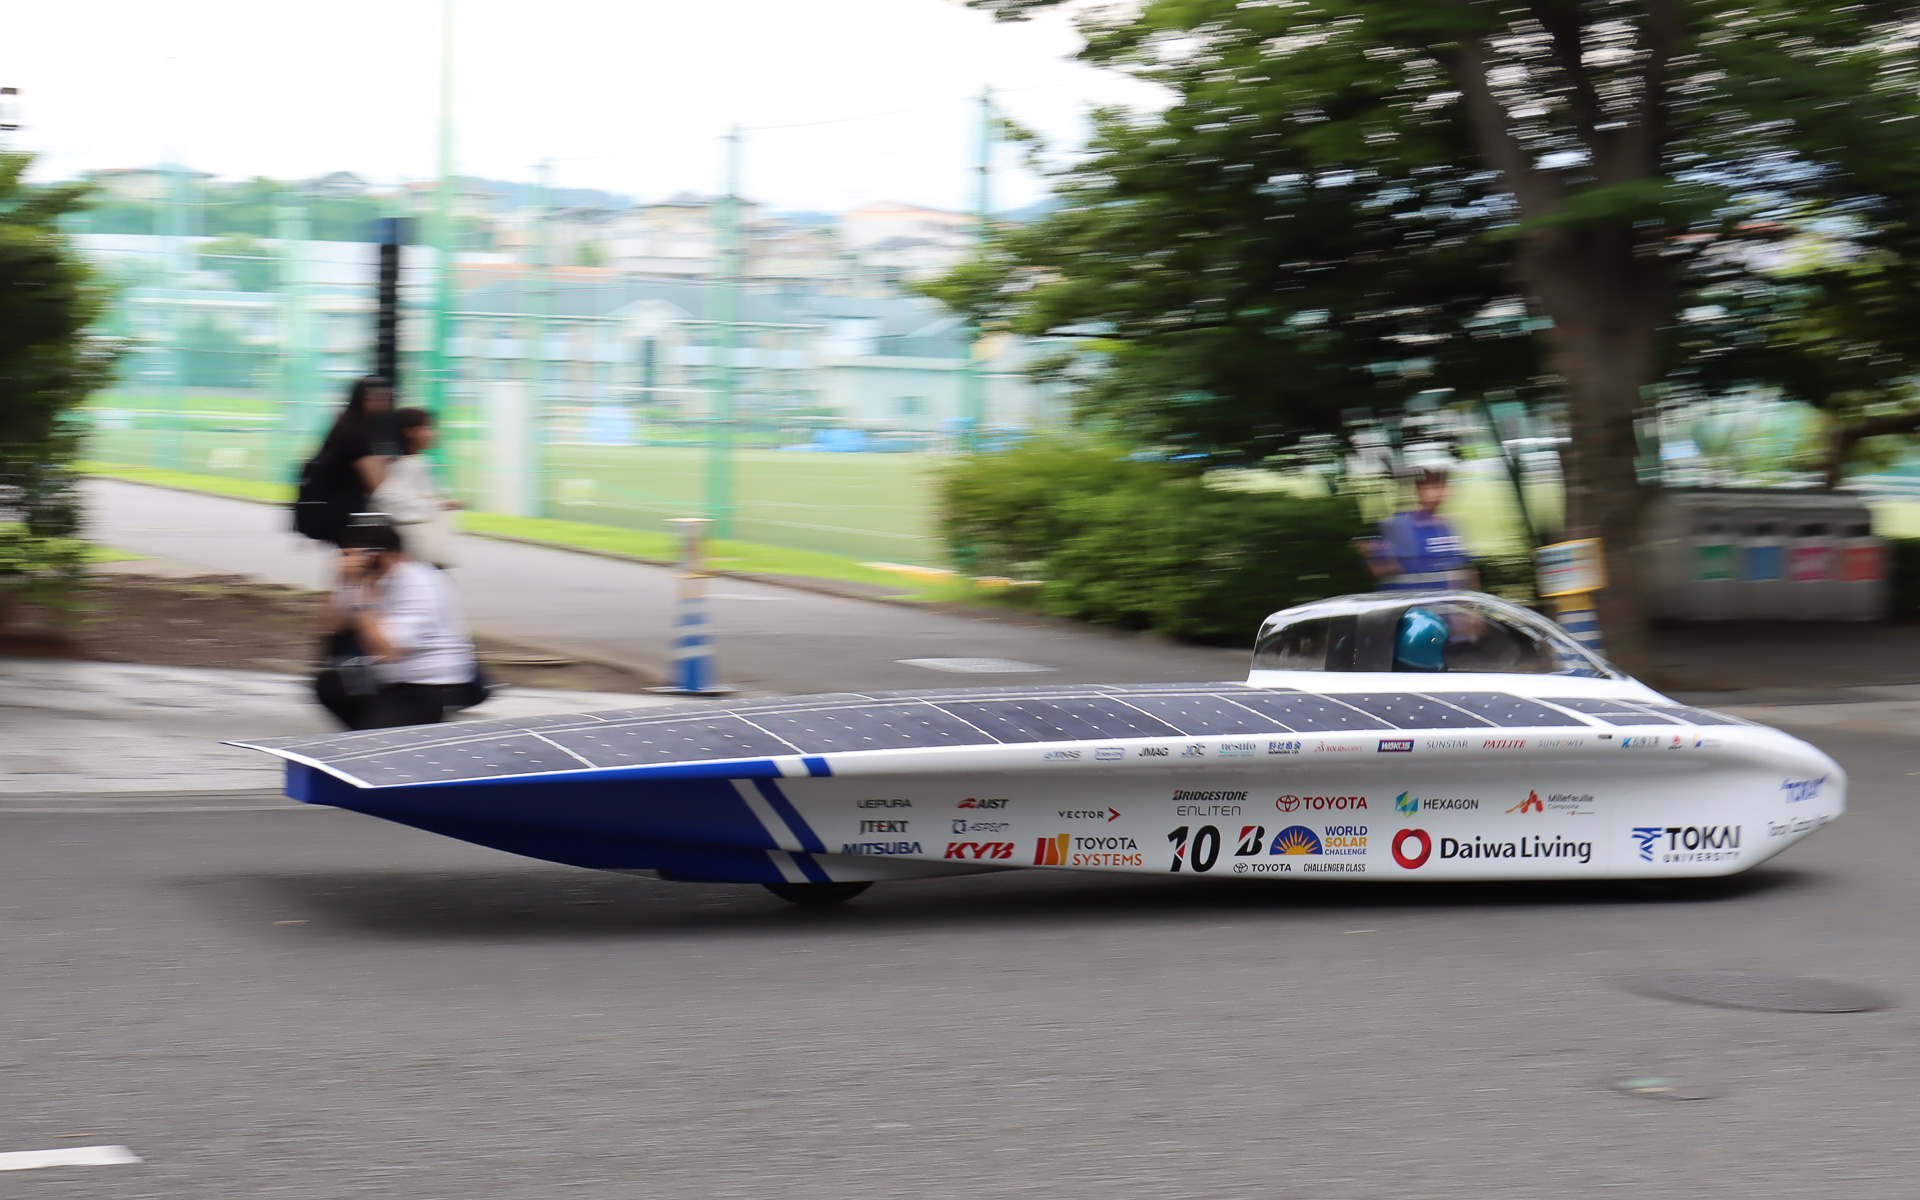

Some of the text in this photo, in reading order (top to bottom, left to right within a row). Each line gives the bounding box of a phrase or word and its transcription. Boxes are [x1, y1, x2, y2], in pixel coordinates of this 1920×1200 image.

[1426, 740, 1468, 748] SUNSTAR
[1483, 740, 1527, 748] PATLITE
[1173, 790, 1248, 800] BRIDGESTONE
[976, 799, 1009, 808] AIST
[1303, 797, 1368, 810] TOYOTA
[1423, 799, 1479, 810] HEXAGON
[858, 820, 909, 835] JTEKT
[1325, 826, 1368, 836] WORLD
[1325, 837, 1368, 847] SOLAR
[1666, 825, 1741, 850] TOKAI
[842, 841, 923, 855] MITSUBA
[1075, 837, 1137, 850] TOYOTA
[1167, 825, 1221, 873] 10
[1440, 834, 1592, 863] Daiwa Living
[943, 842, 1015, 859] KYB
[1325, 848, 1367, 856] CHALLENGE
[1072, 853, 1143, 866] SYSTEMS
[1251, 863, 1292, 872] TOYOTA
[1303, 863, 1366, 872] CHALLENGER CLASS
